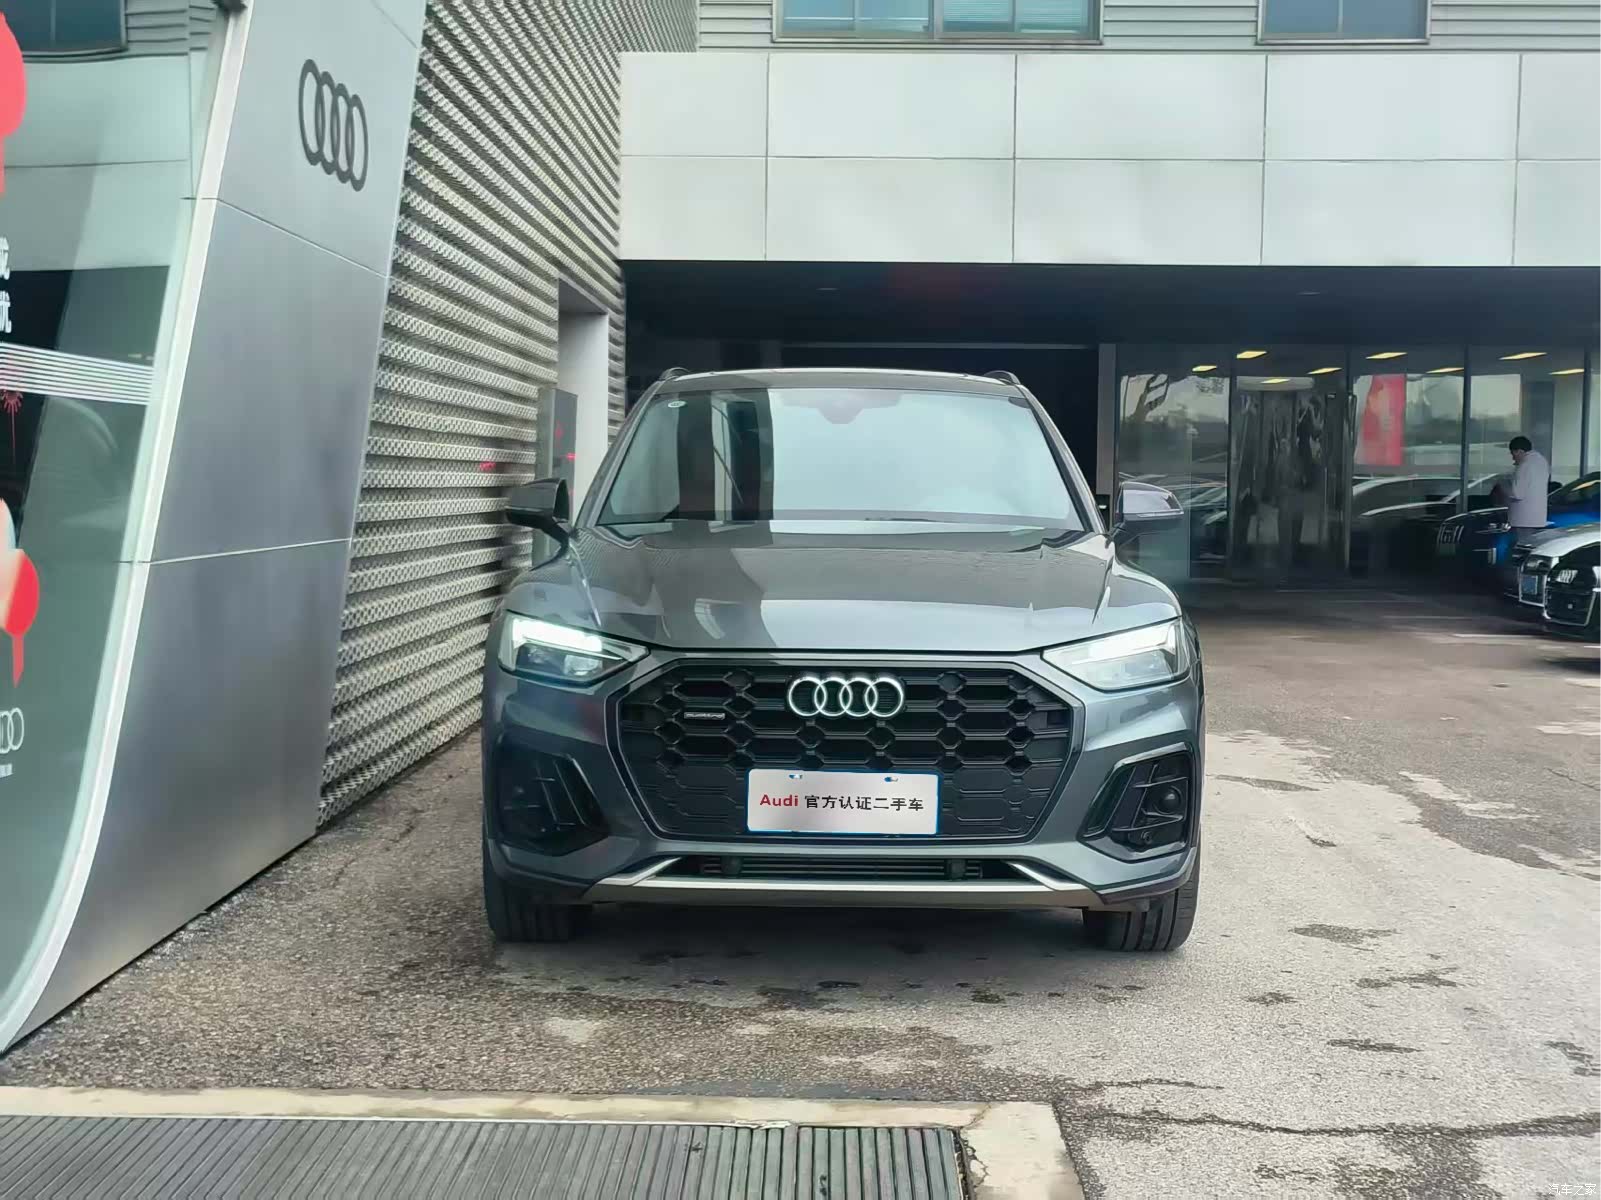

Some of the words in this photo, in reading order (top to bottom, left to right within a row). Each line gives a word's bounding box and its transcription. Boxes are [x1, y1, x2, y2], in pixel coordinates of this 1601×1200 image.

[759, 794, 799, 807] Audi
[805, 795, 924, 812] 官方认证二手车
